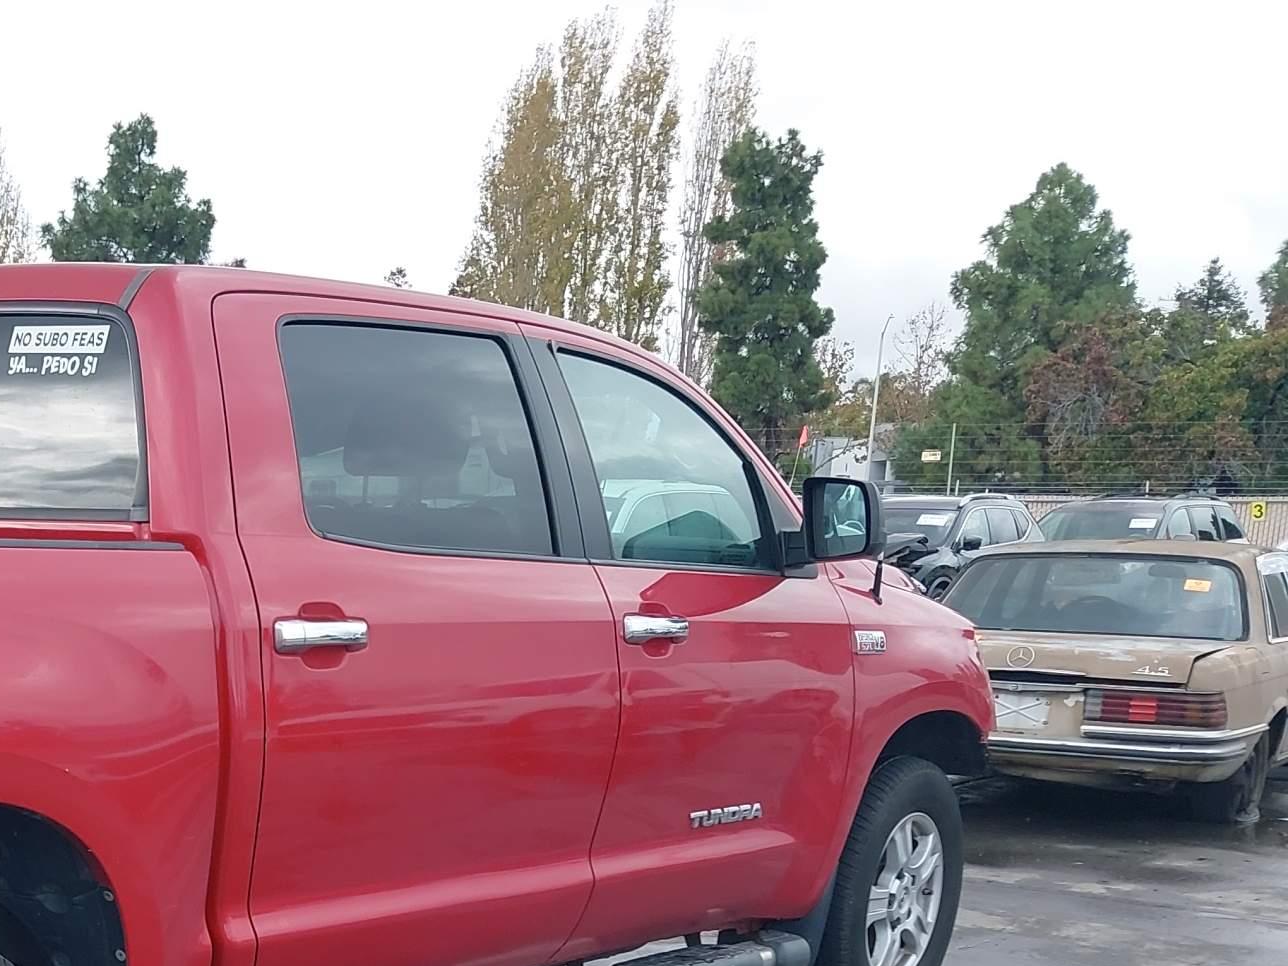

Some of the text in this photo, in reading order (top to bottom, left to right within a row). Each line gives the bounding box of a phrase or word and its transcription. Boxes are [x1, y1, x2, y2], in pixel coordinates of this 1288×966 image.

[13, 331, 105, 347] NO SUBO FEAS
[40, 355, 81, 376] PEDO
[81, 354, 99, 377] SI
[1253, 503, 1264, 519] 3
[689, 802, 763, 829] TUNDRA
